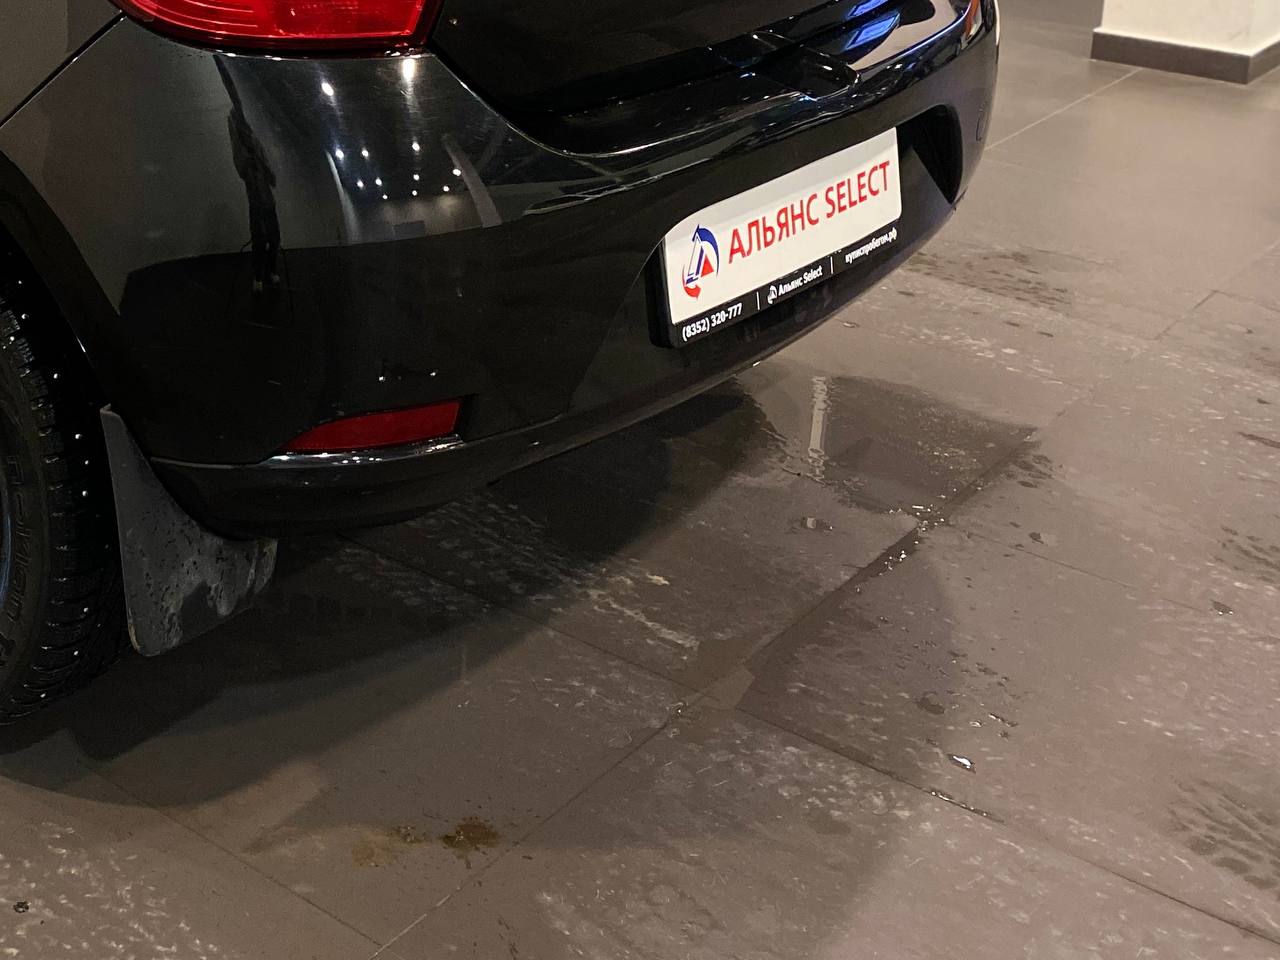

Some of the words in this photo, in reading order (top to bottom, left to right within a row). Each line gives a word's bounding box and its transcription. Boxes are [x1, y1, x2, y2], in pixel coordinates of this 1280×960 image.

[728, 193, 820, 265] АЛЬЯНС
[824, 160, 890, 219] SELECT
[778, 276, 803, 296] Альянс
[803, 265, 823, 284] Select
[682, 317, 711, 342] (8352)
[711, 302, 743, 328] 320-777
